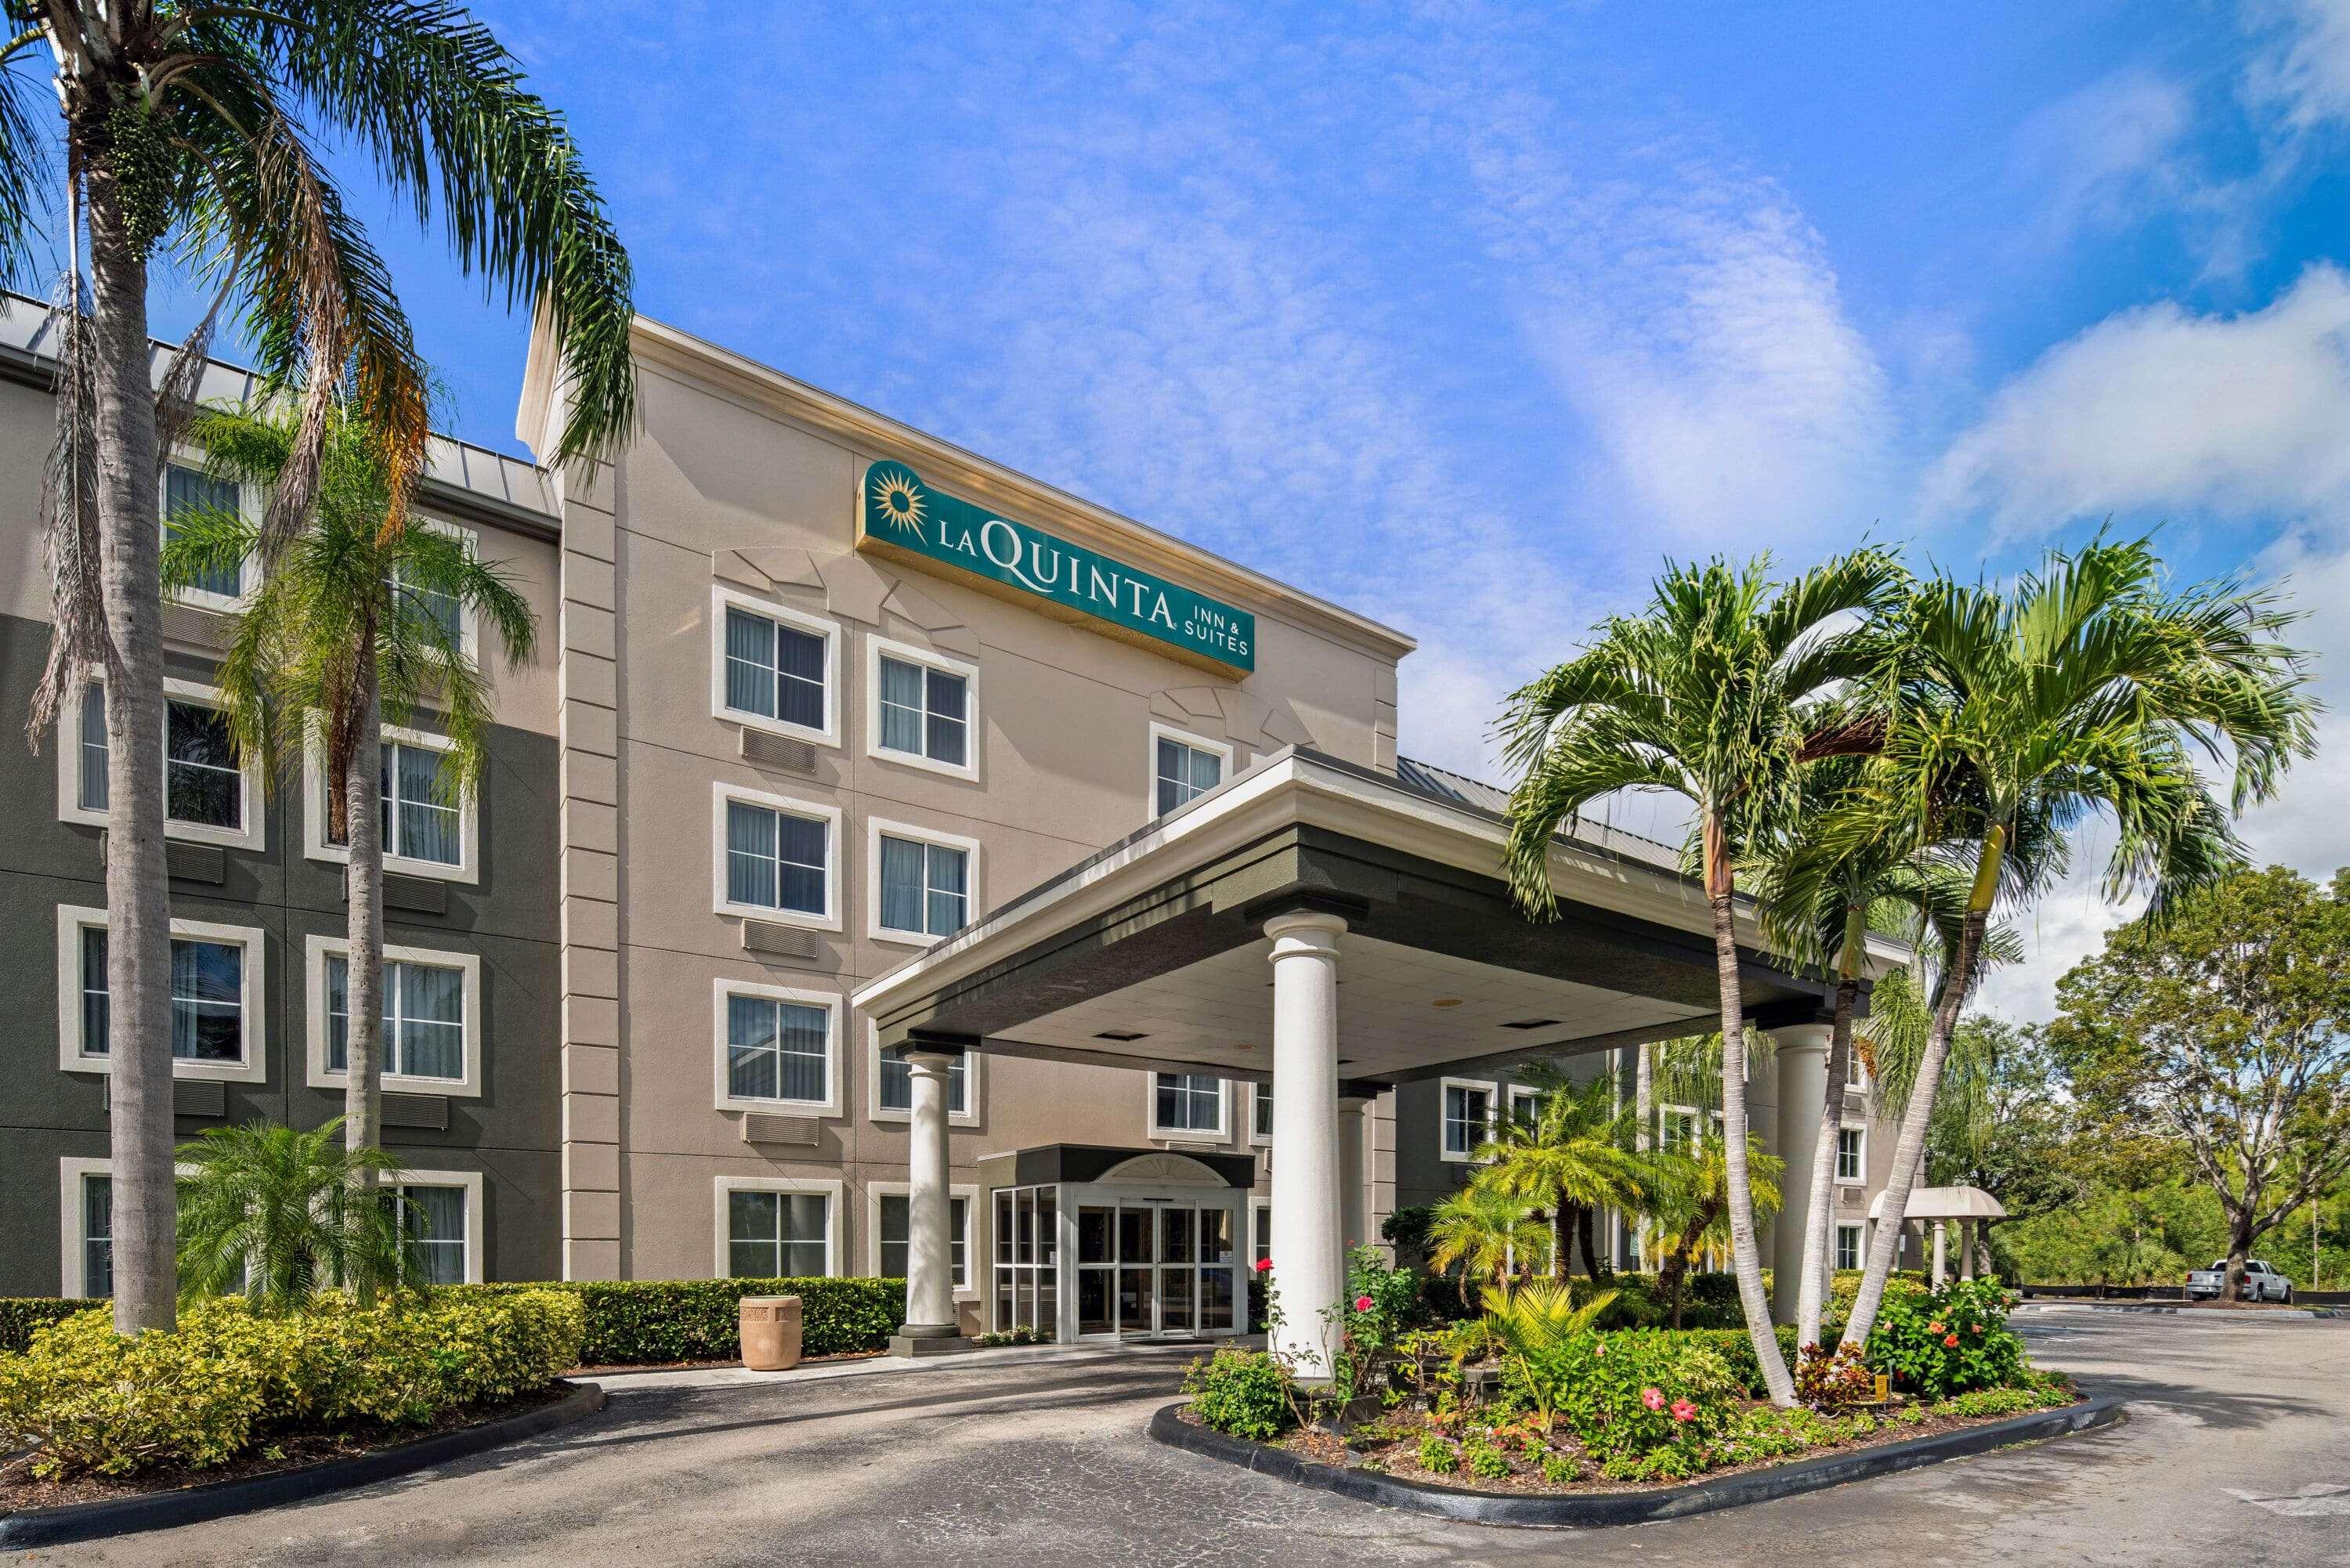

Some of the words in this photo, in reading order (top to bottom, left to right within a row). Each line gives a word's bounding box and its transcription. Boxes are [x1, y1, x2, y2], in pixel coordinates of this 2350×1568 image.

[938, 519, 978, 557] LA
[981, 520, 1177, 630] QUINTA
[1184, 620, 1248, 656] SUITES
[1194, 605, 1224, 630] INN
[1230, 623, 1238, 635] &
